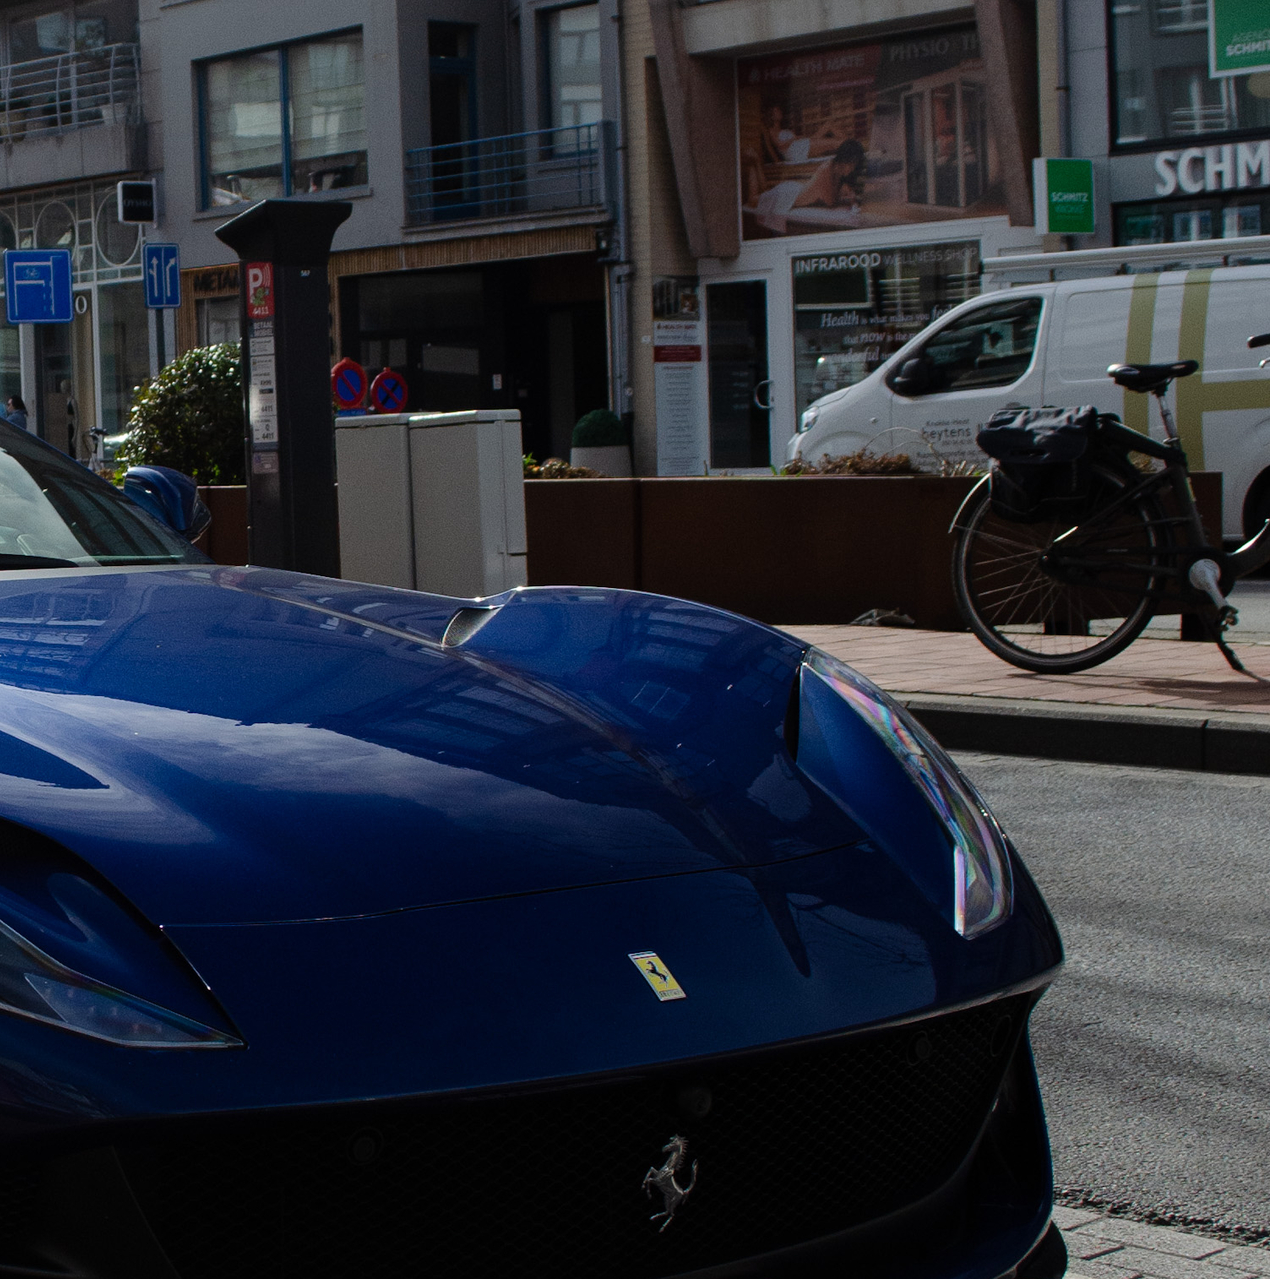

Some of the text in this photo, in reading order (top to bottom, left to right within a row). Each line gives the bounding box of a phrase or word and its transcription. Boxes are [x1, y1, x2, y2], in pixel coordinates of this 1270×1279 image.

[1051, 192, 1089, 203] SCHMITZ
[795, 247, 979, 274] INFRAROOD WELLNESS SHOP
[820, 311, 859, 328] Health
